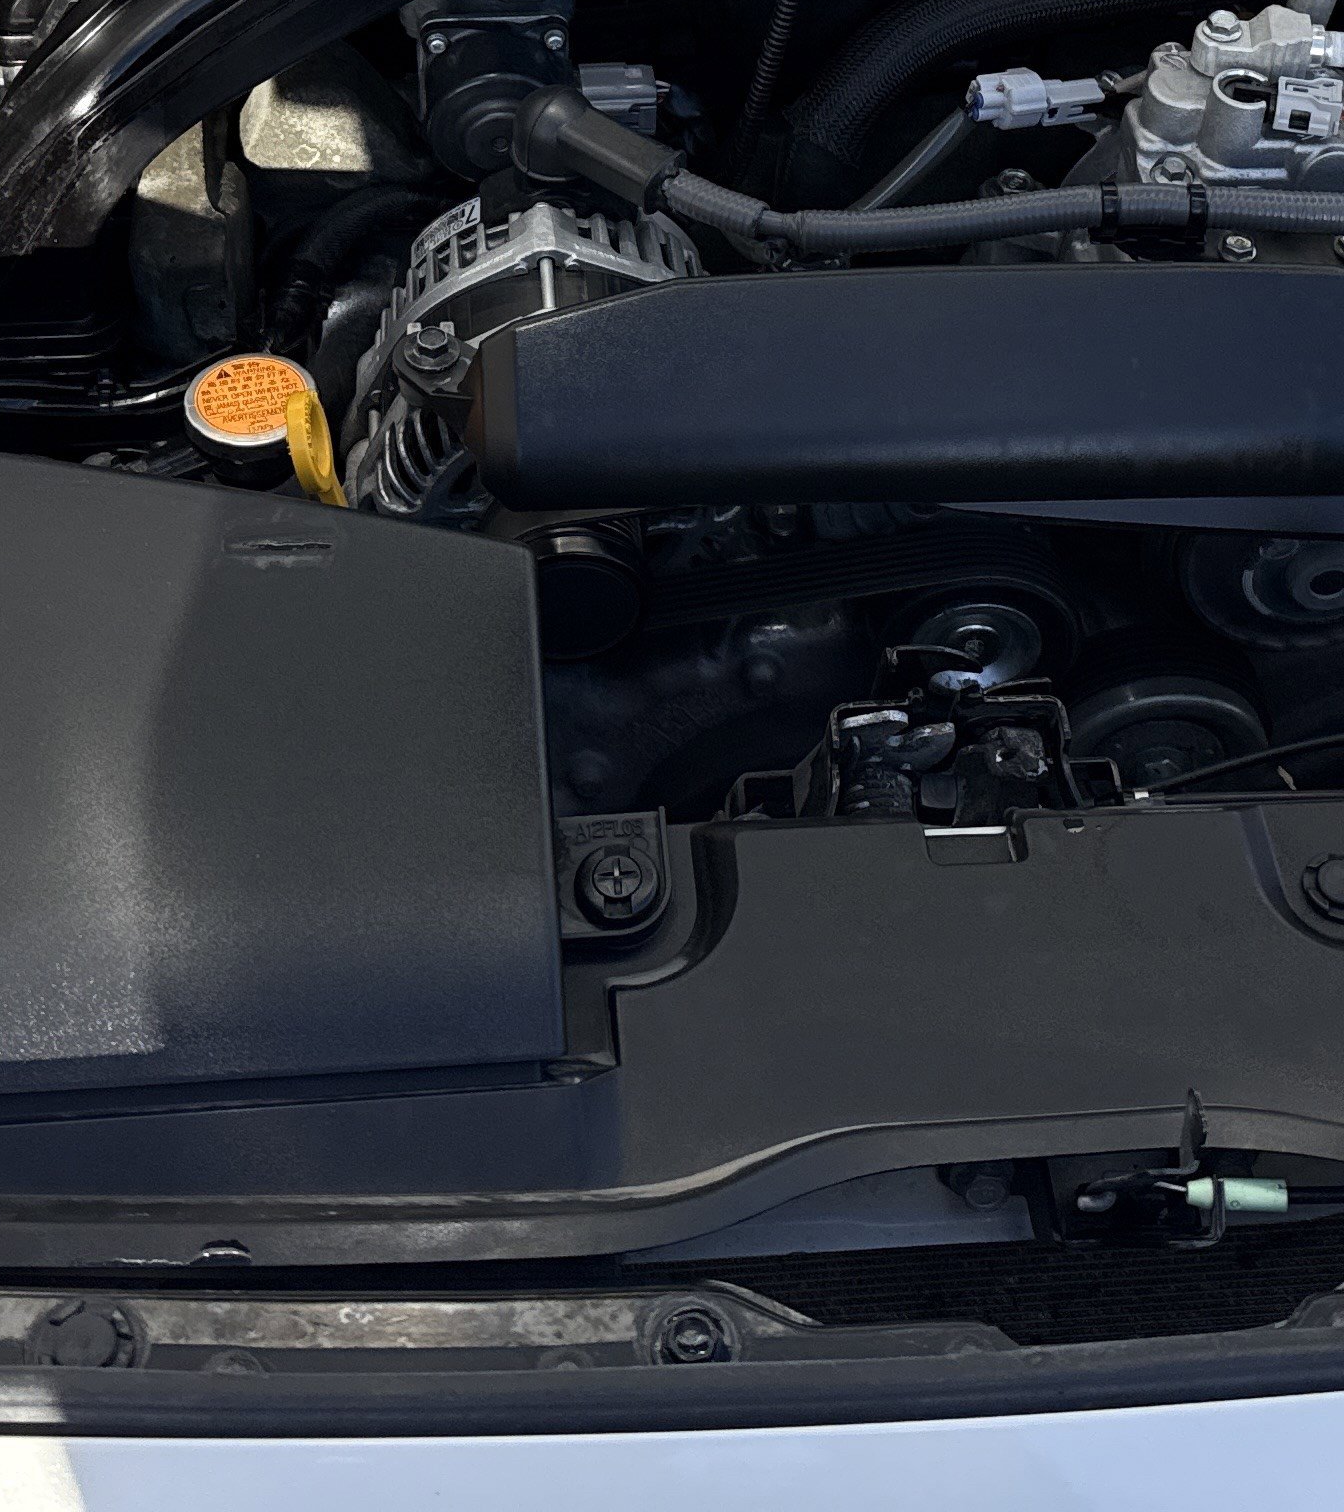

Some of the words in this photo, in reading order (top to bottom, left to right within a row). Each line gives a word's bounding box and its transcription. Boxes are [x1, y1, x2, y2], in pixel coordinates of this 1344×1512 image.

[233, 365, 276, 376] WARNING
[202, 394, 228, 404] NEVER
[231, 390, 253, 399] OPEN
[282, 382, 298, 390] HOT
[223, 406, 287, 424] AVERTISSEMEN
